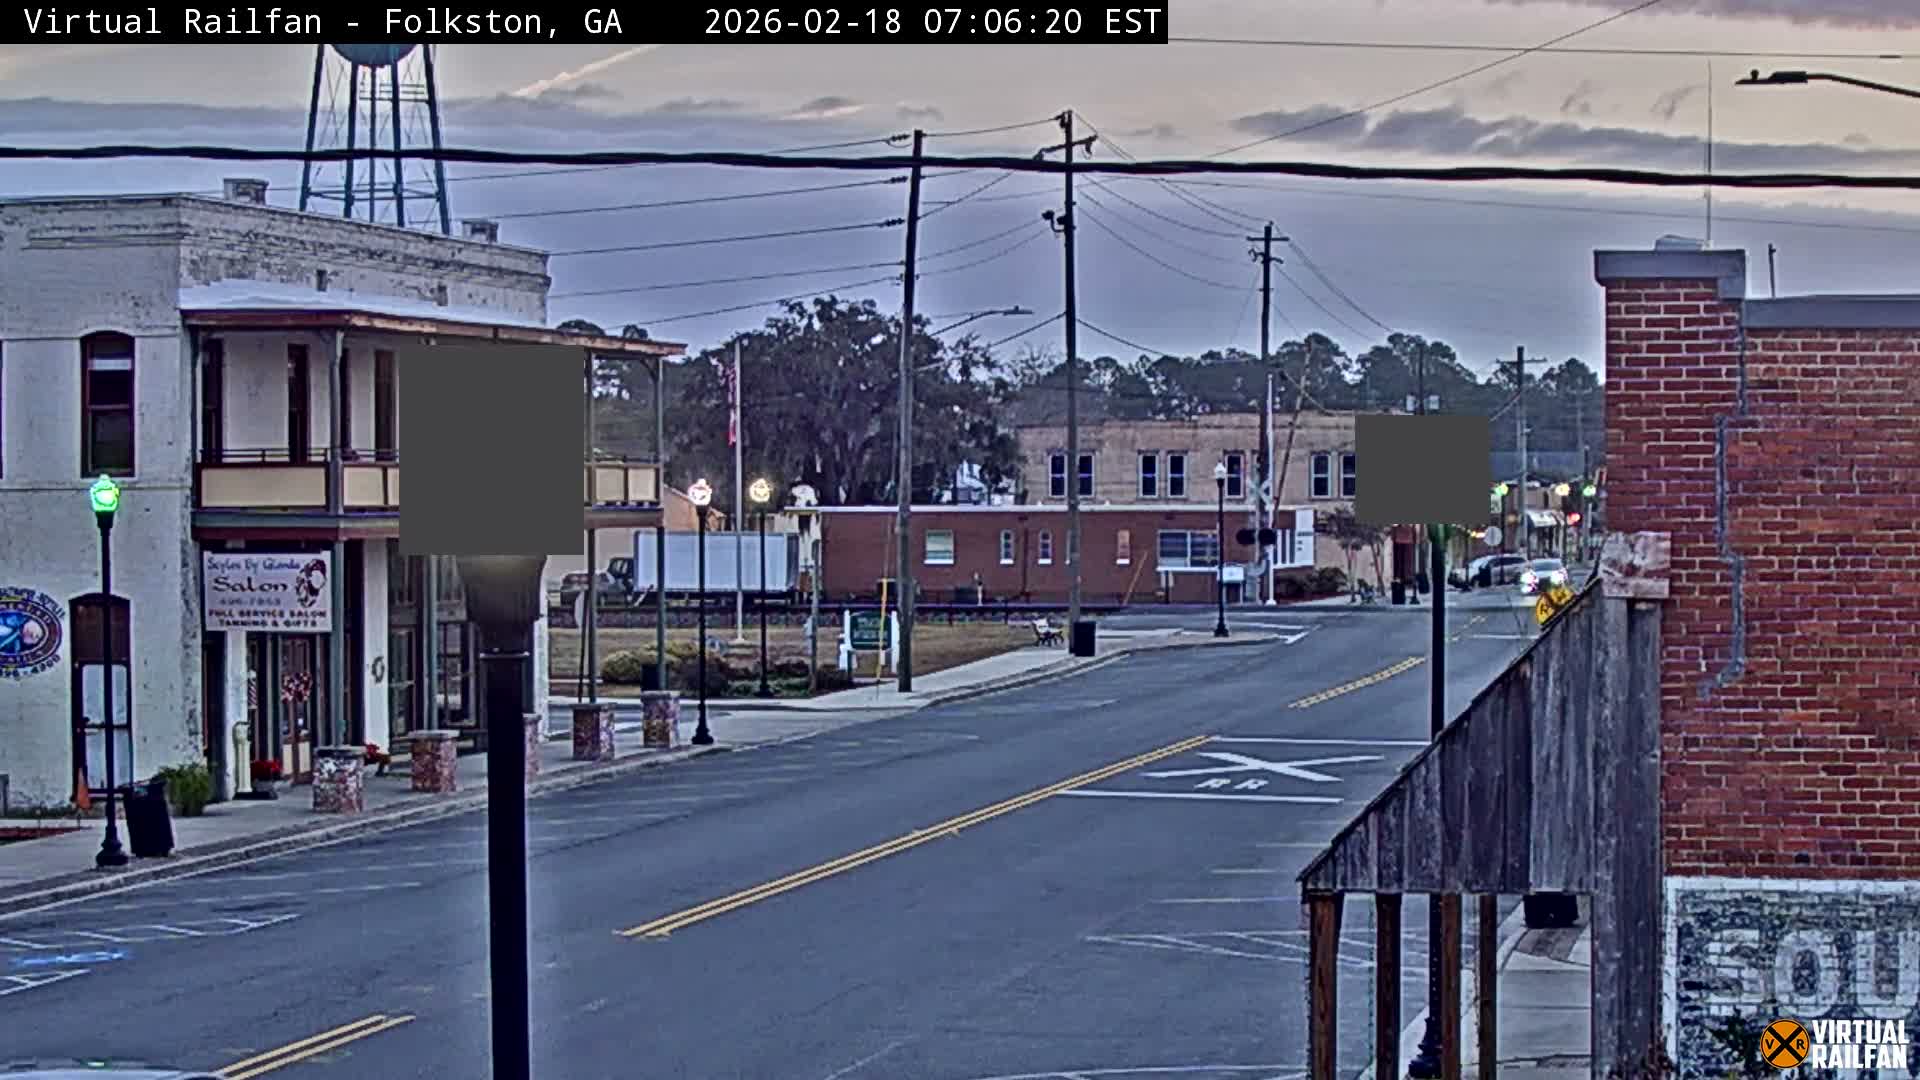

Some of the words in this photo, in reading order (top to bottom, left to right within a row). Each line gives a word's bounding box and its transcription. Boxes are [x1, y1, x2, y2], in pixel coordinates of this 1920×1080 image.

[212, 576, 288, 592] Salon
[208, 609, 234, 618] FULL
[239, 609, 285, 618] SERVICE
[289, 609, 327, 618] SALON
[218, 619, 268, 628] TANNING
[283, 619, 317, 628] GIFTS
